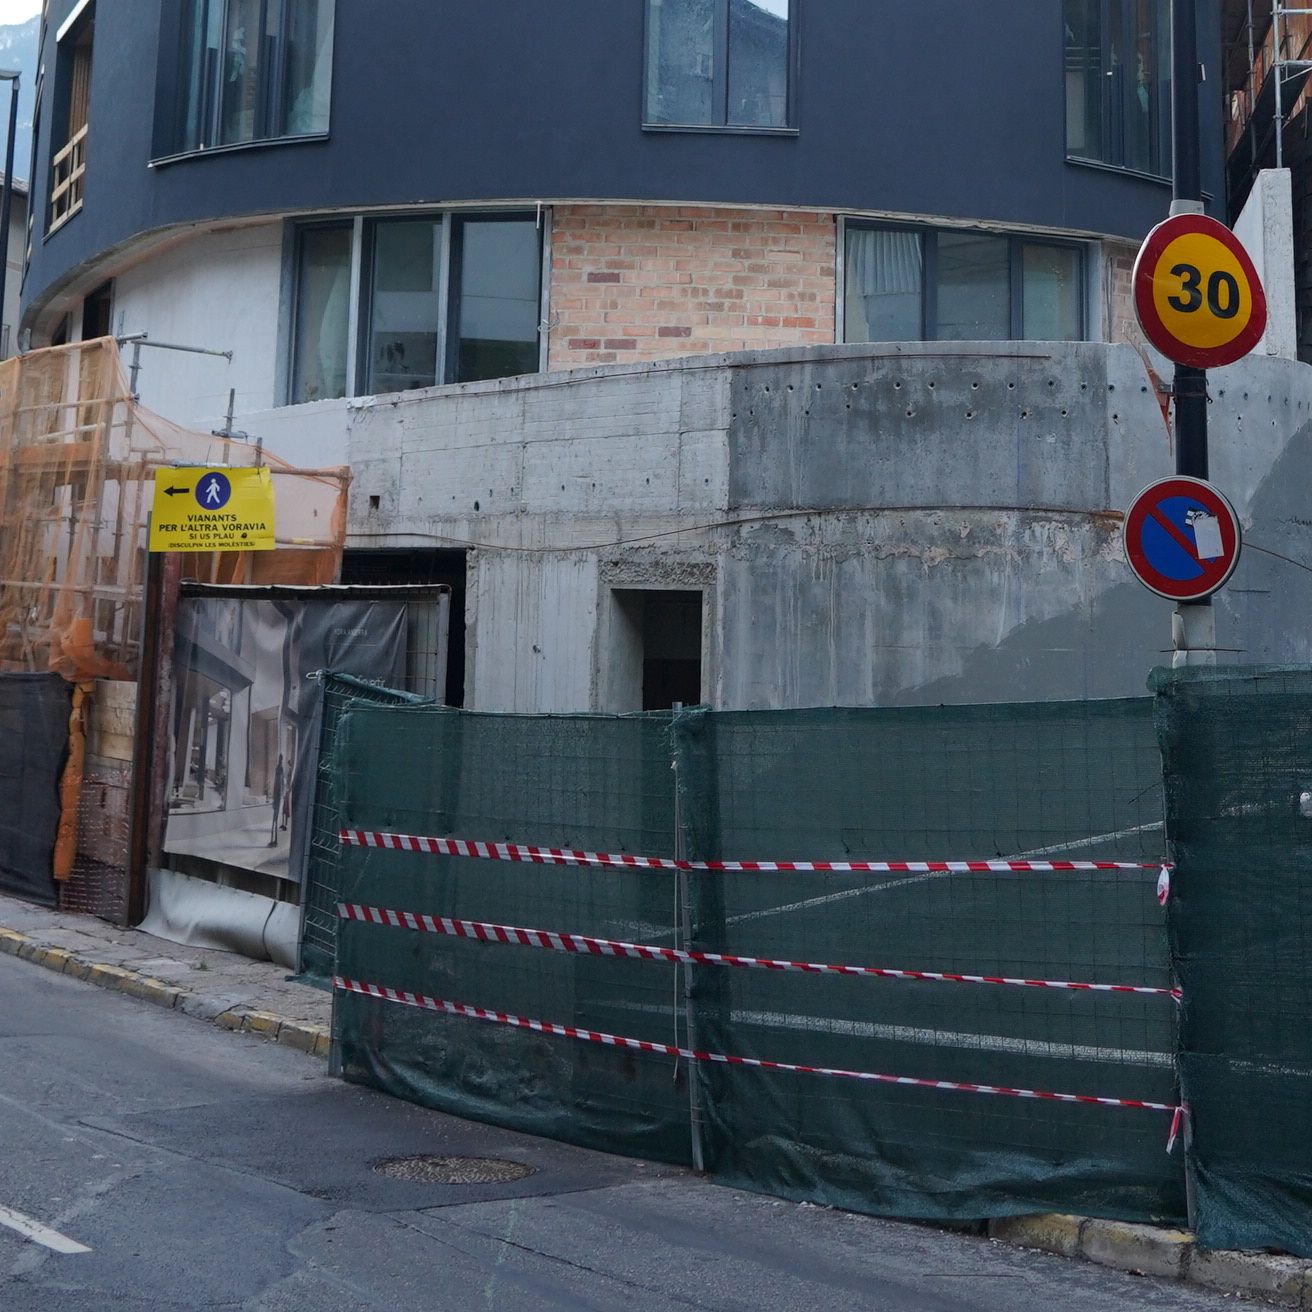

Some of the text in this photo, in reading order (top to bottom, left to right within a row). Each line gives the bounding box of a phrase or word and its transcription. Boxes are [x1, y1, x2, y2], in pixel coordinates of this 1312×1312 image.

[1168, 263, 1239, 320] 30
[187, 514, 237, 522] VIANANTS
[159, 523, 266, 532] PER L'ALTRA VORAVIA
